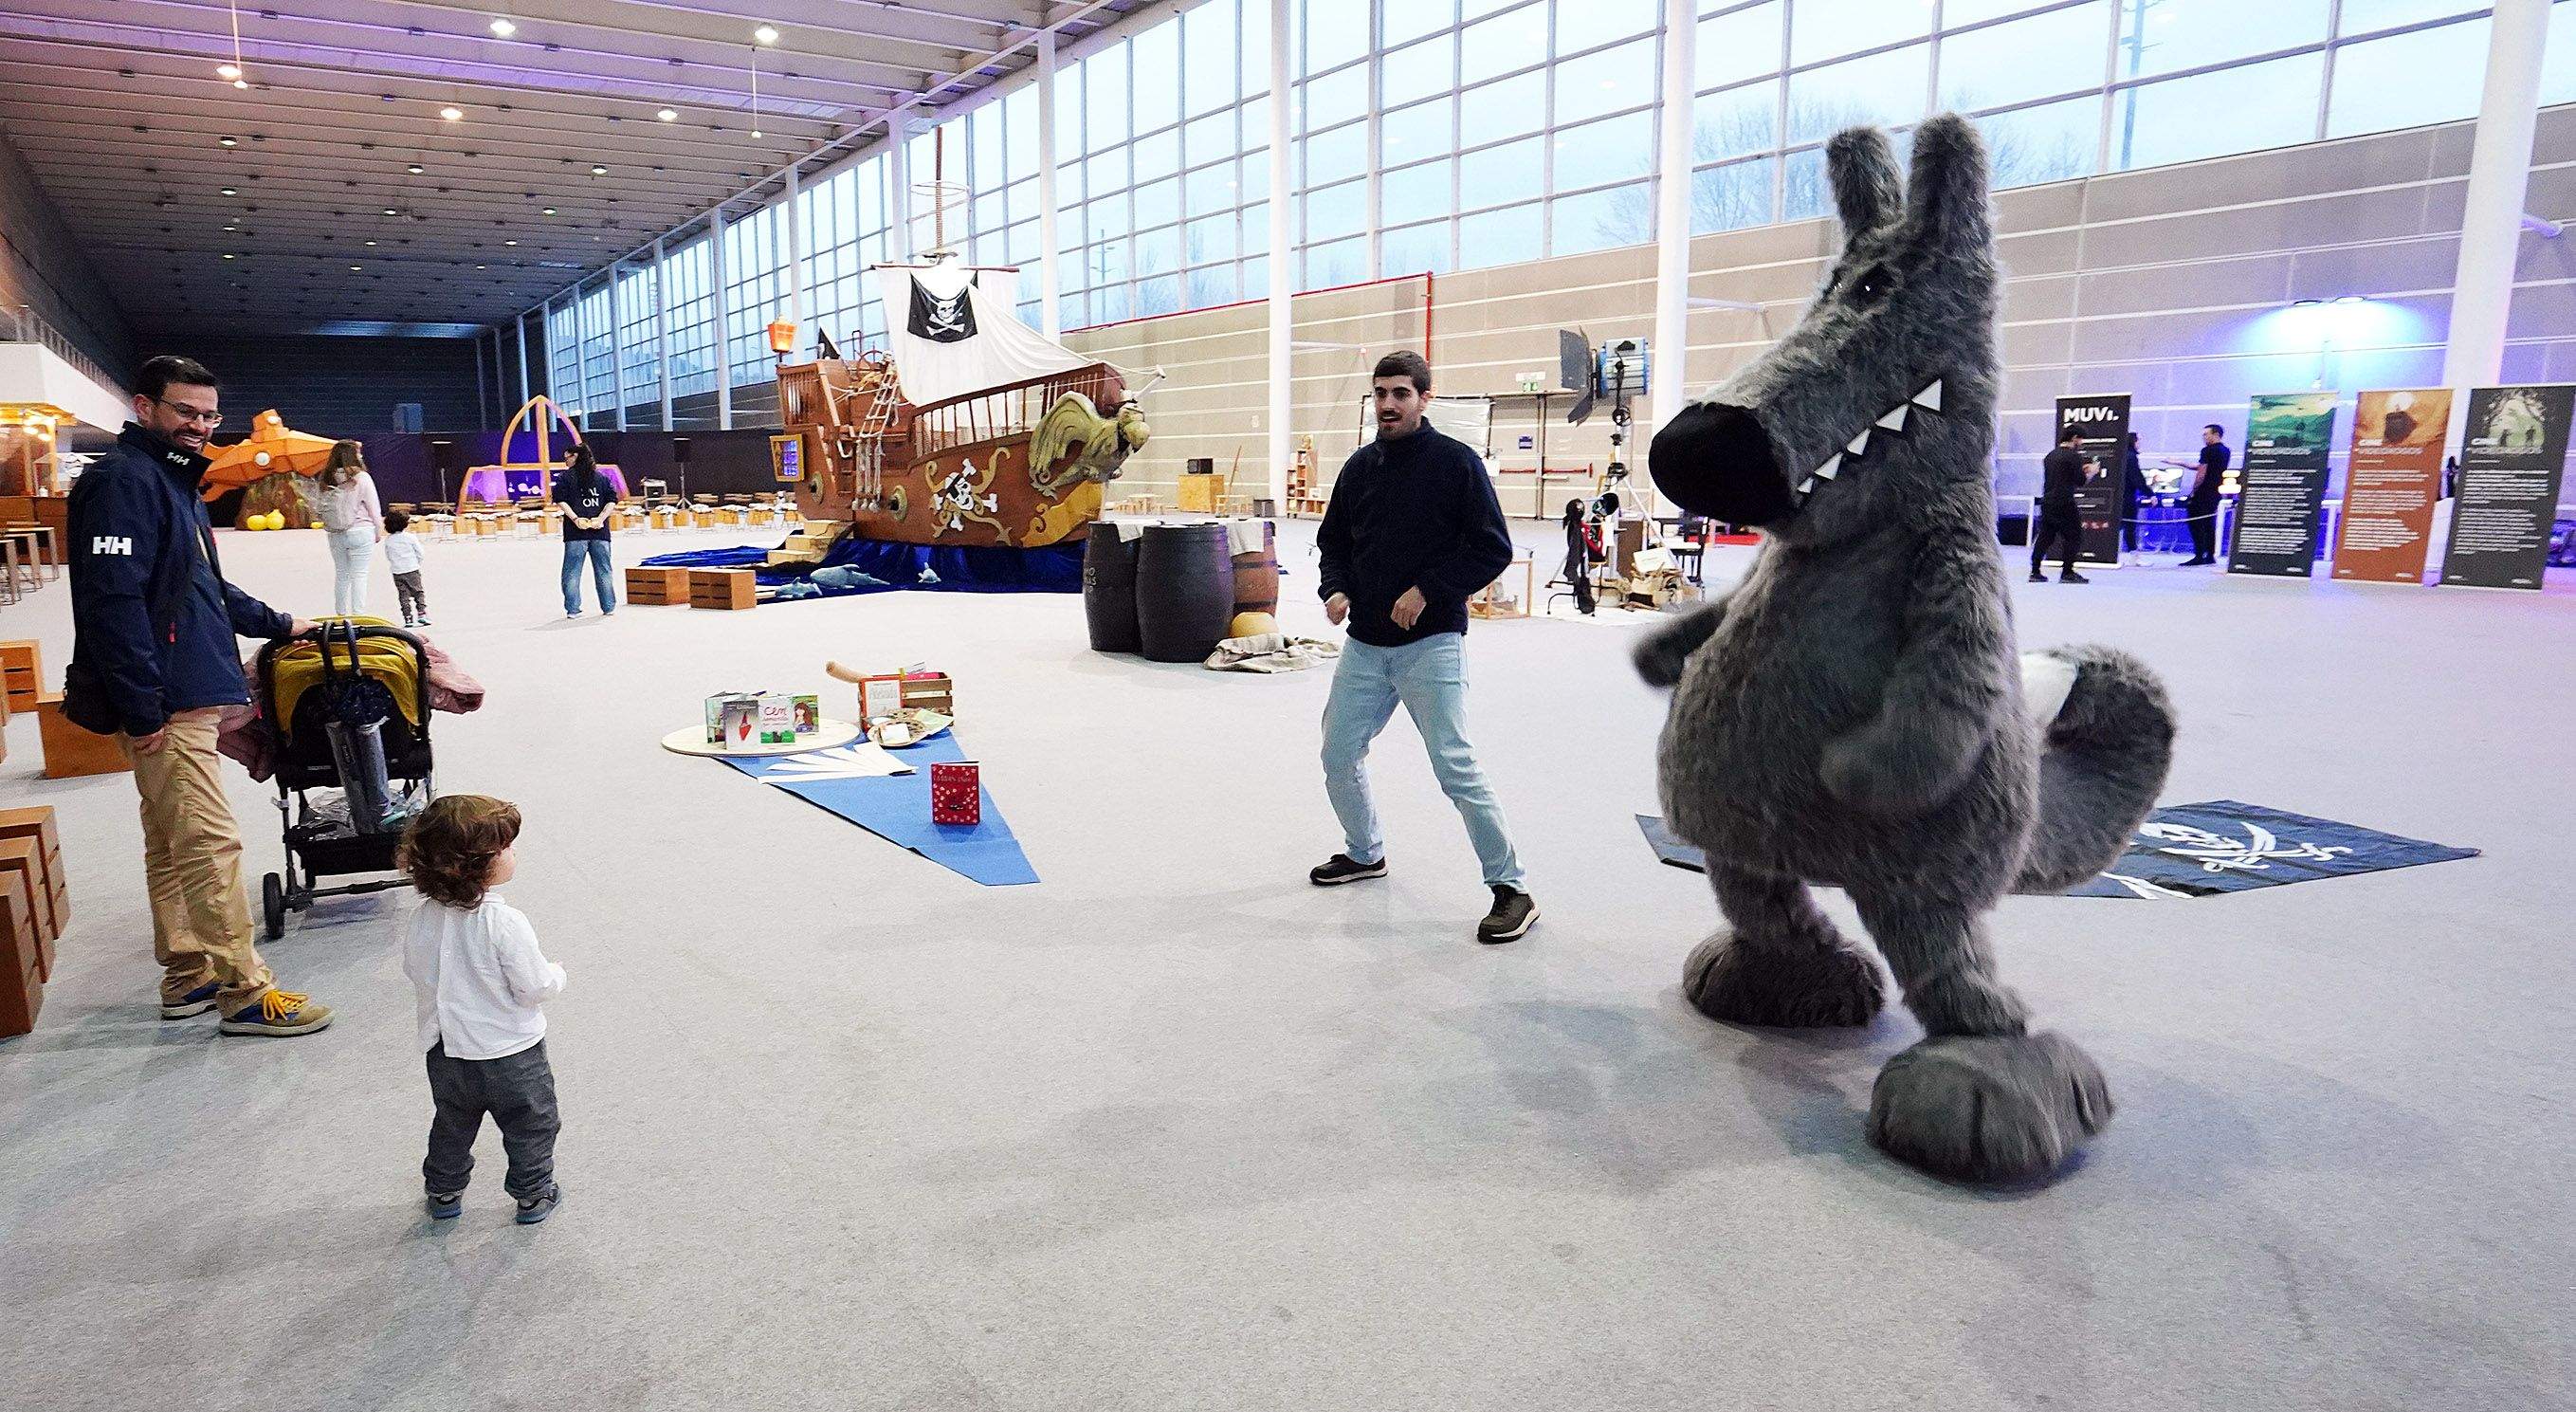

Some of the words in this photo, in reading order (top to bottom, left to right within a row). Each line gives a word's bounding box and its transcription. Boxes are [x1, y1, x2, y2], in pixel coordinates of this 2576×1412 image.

[166, 451, 190, 465] HH
[582, 498, 599, 508] ON
[92, 536, 132, 556] HH
